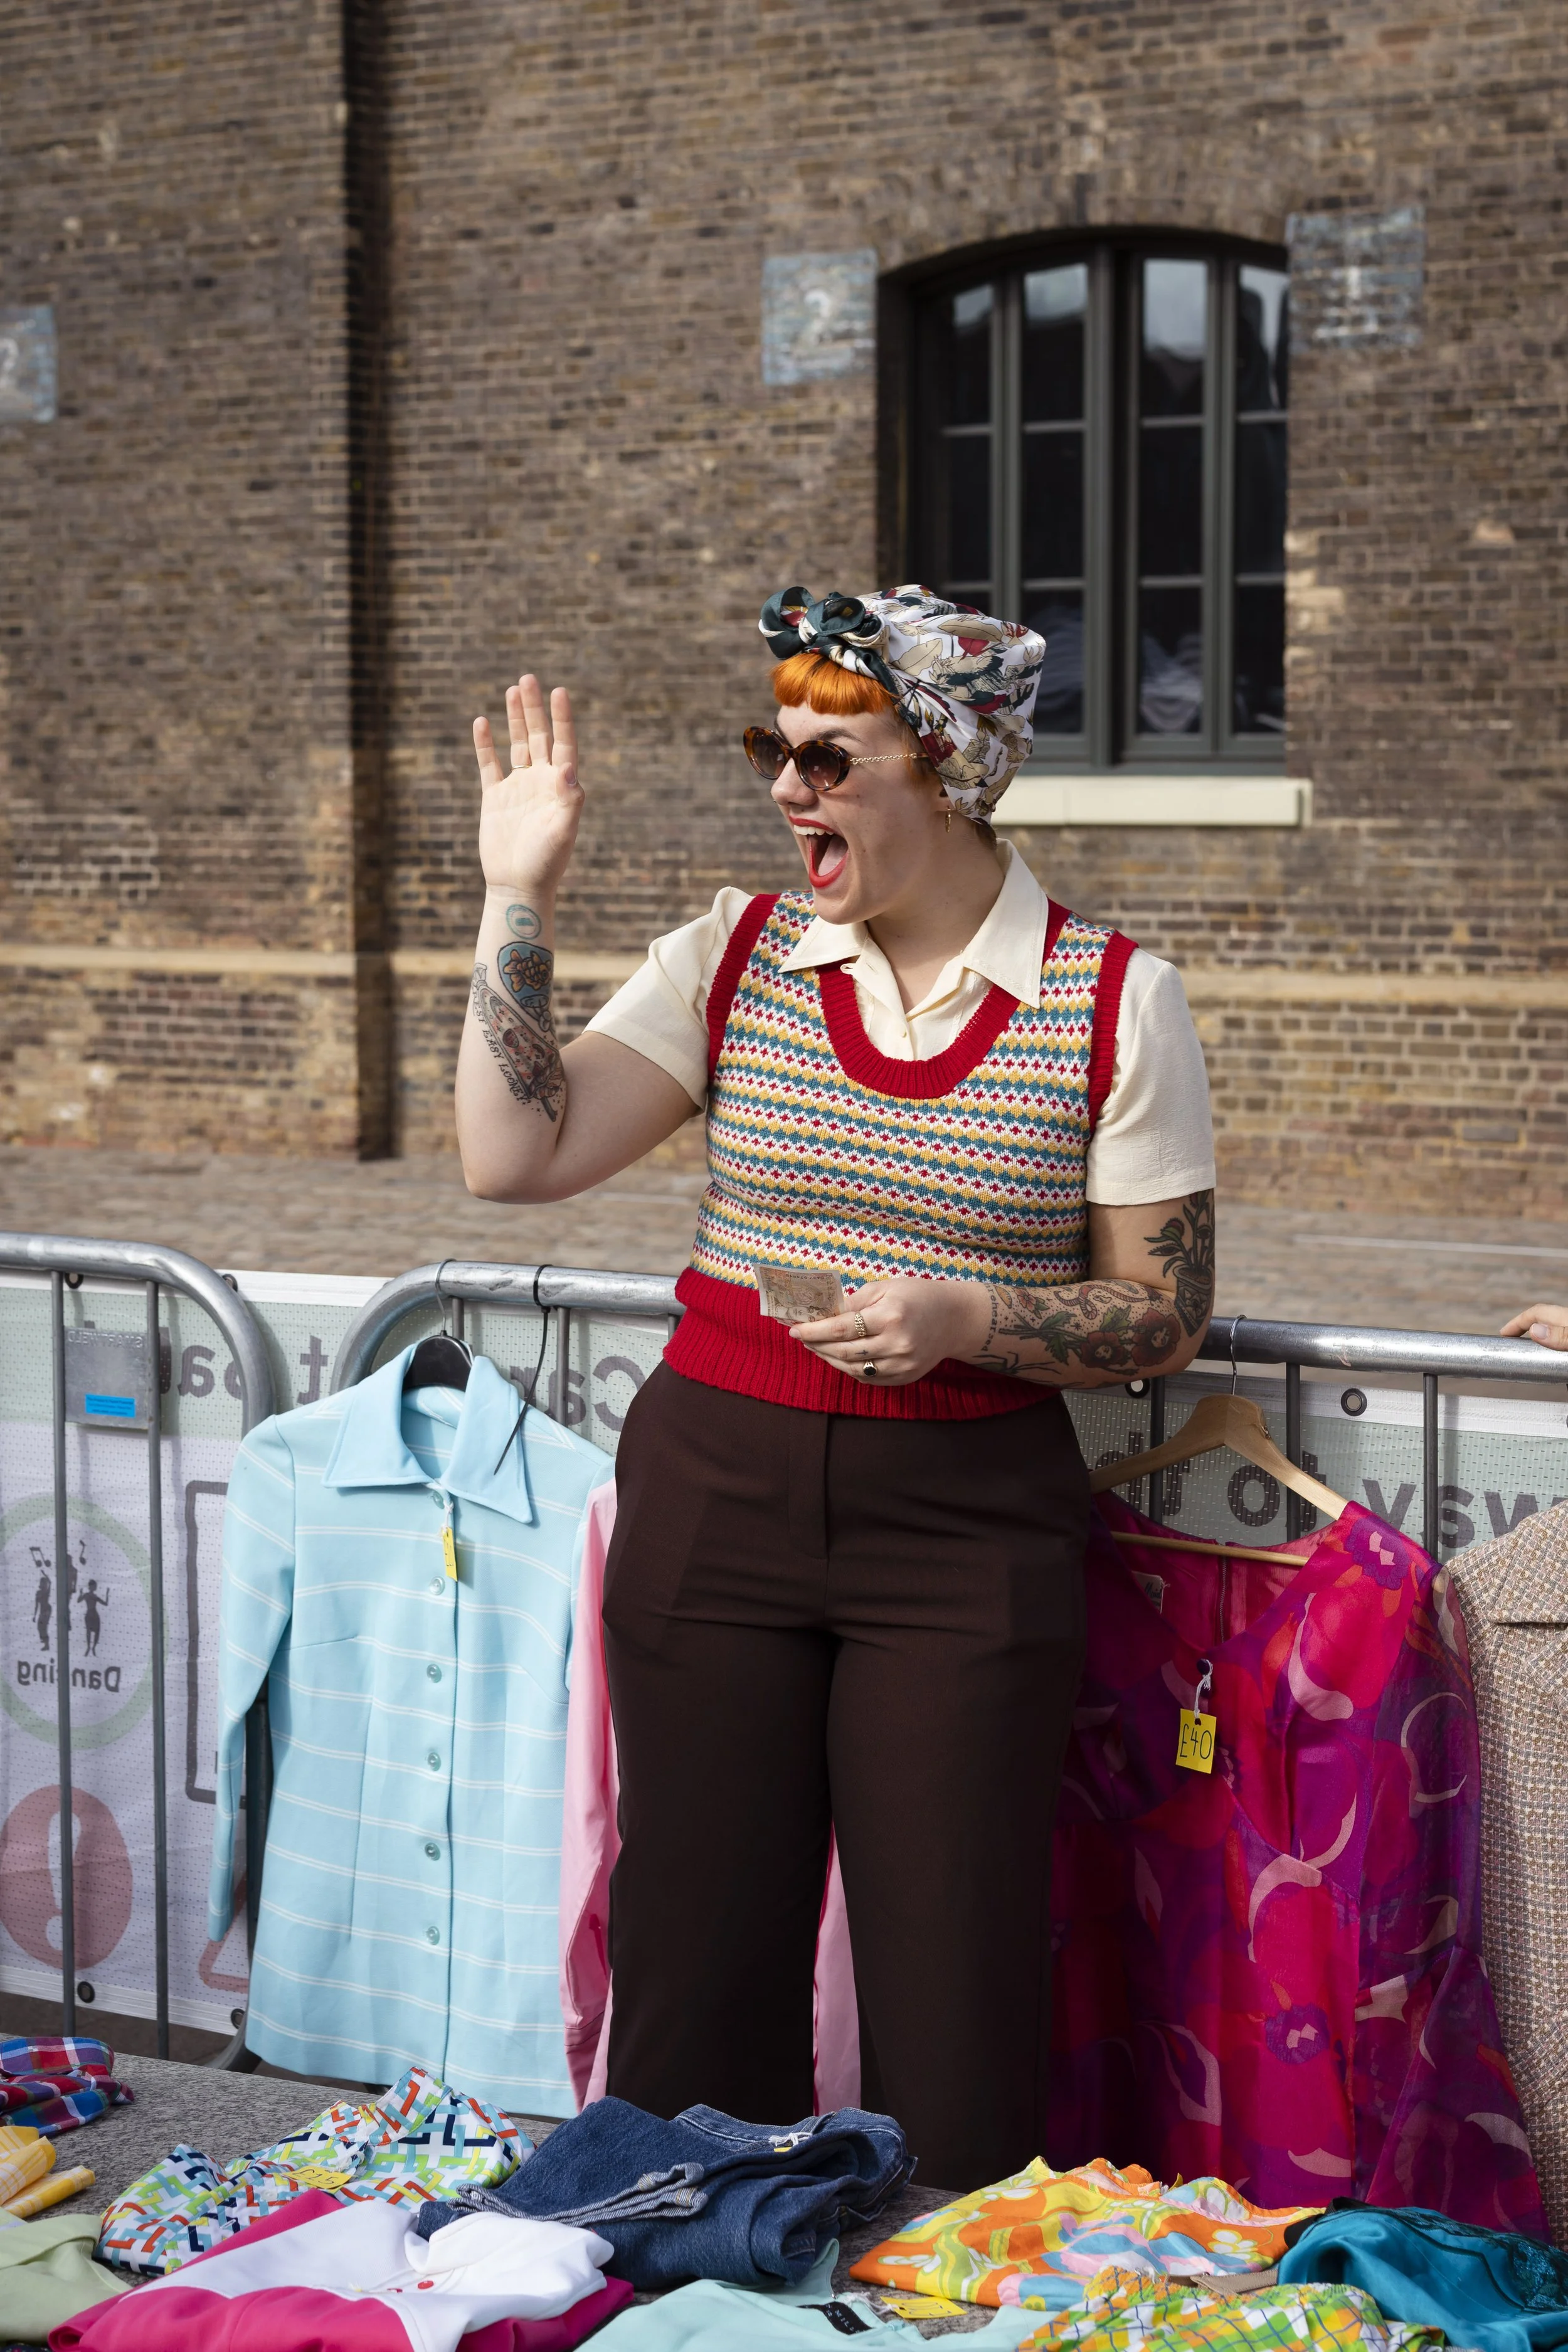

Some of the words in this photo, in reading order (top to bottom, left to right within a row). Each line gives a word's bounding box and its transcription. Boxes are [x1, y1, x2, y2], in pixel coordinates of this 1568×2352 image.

[482, 1030, 504, 1059] EASY
[499, 1063, 528, 1101] LOONEY
[1180, 1723, 1212, 1760] £40
[292, 2169, 339, 2184] £15
